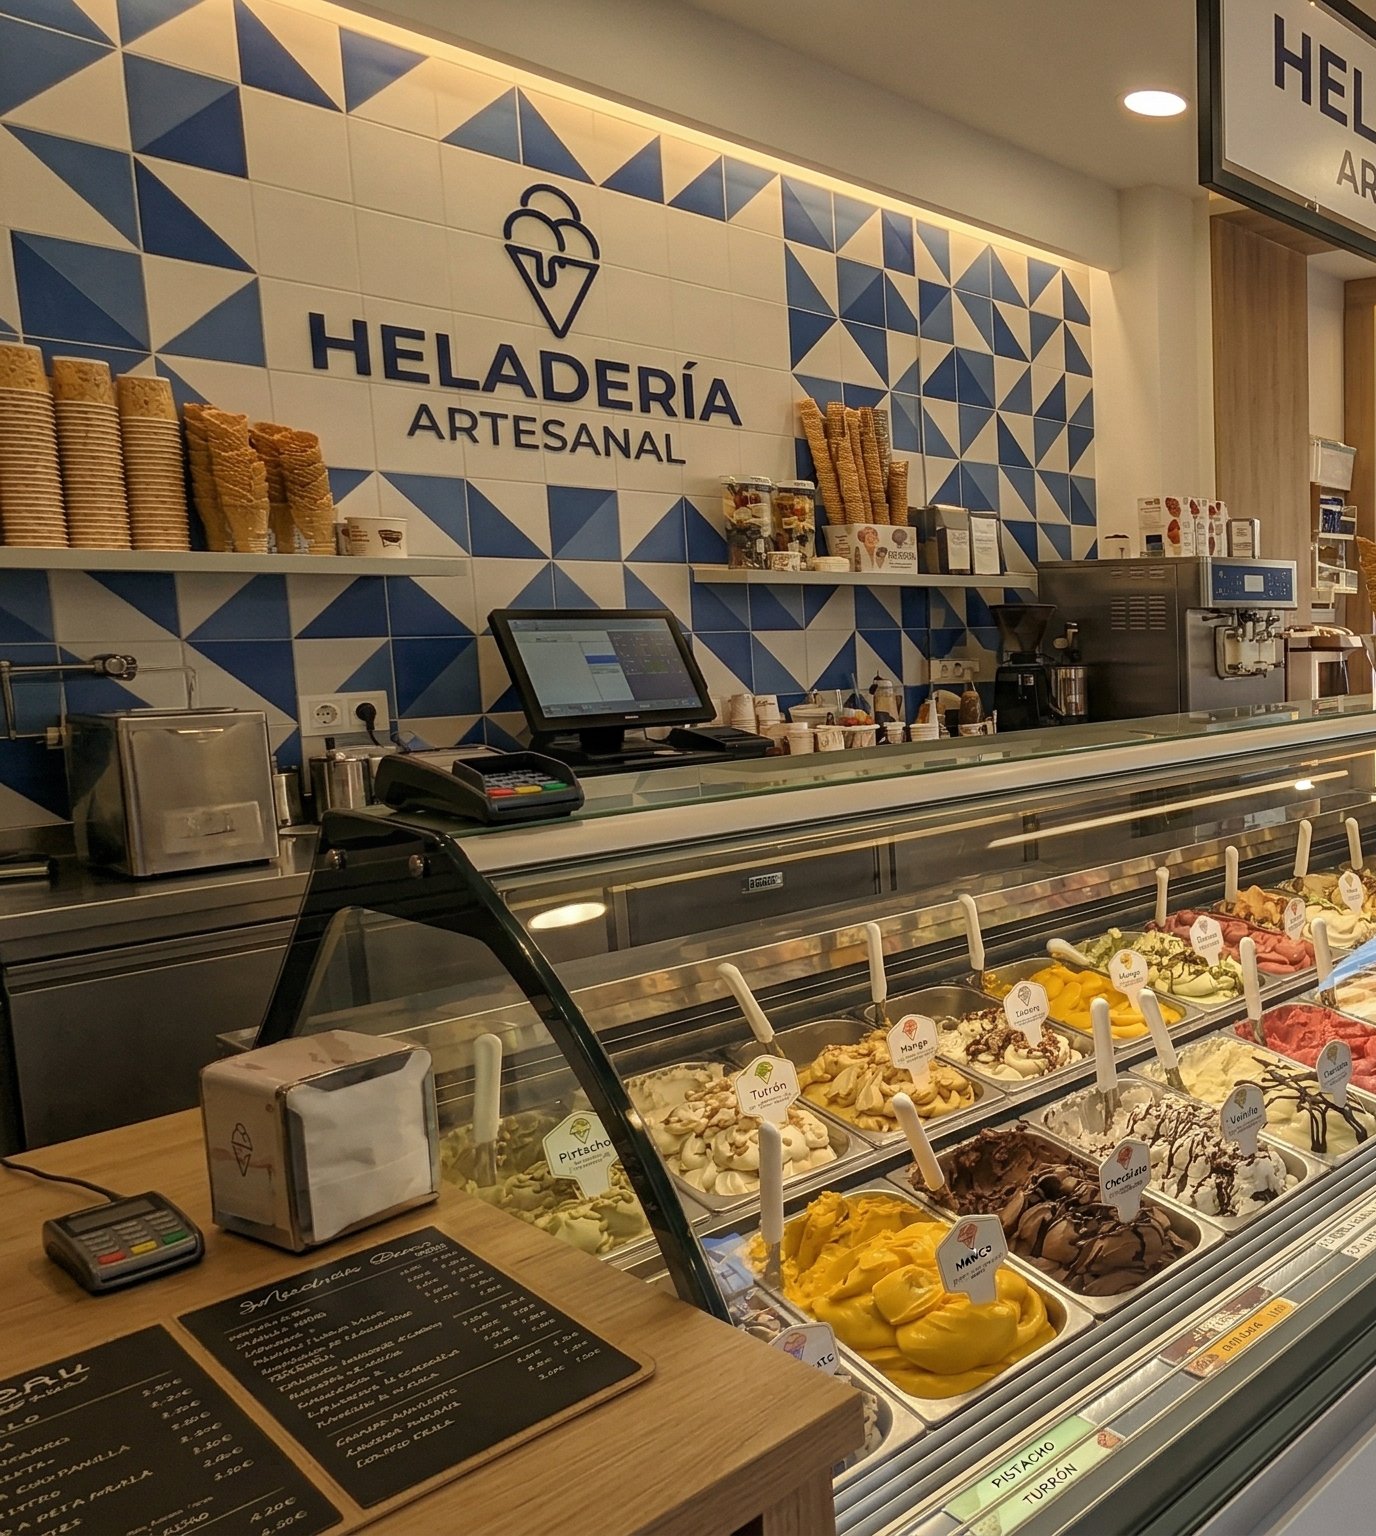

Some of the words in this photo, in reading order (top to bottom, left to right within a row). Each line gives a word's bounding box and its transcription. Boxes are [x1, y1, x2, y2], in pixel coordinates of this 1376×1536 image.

[308, 311, 743, 427] HELADERÍA
[407, 403, 687, 465] ARTESANAL
[991, 1441, 1055, 1488] PISTACHO
[1022, 1463, 1078, 1505] TURRÓN
